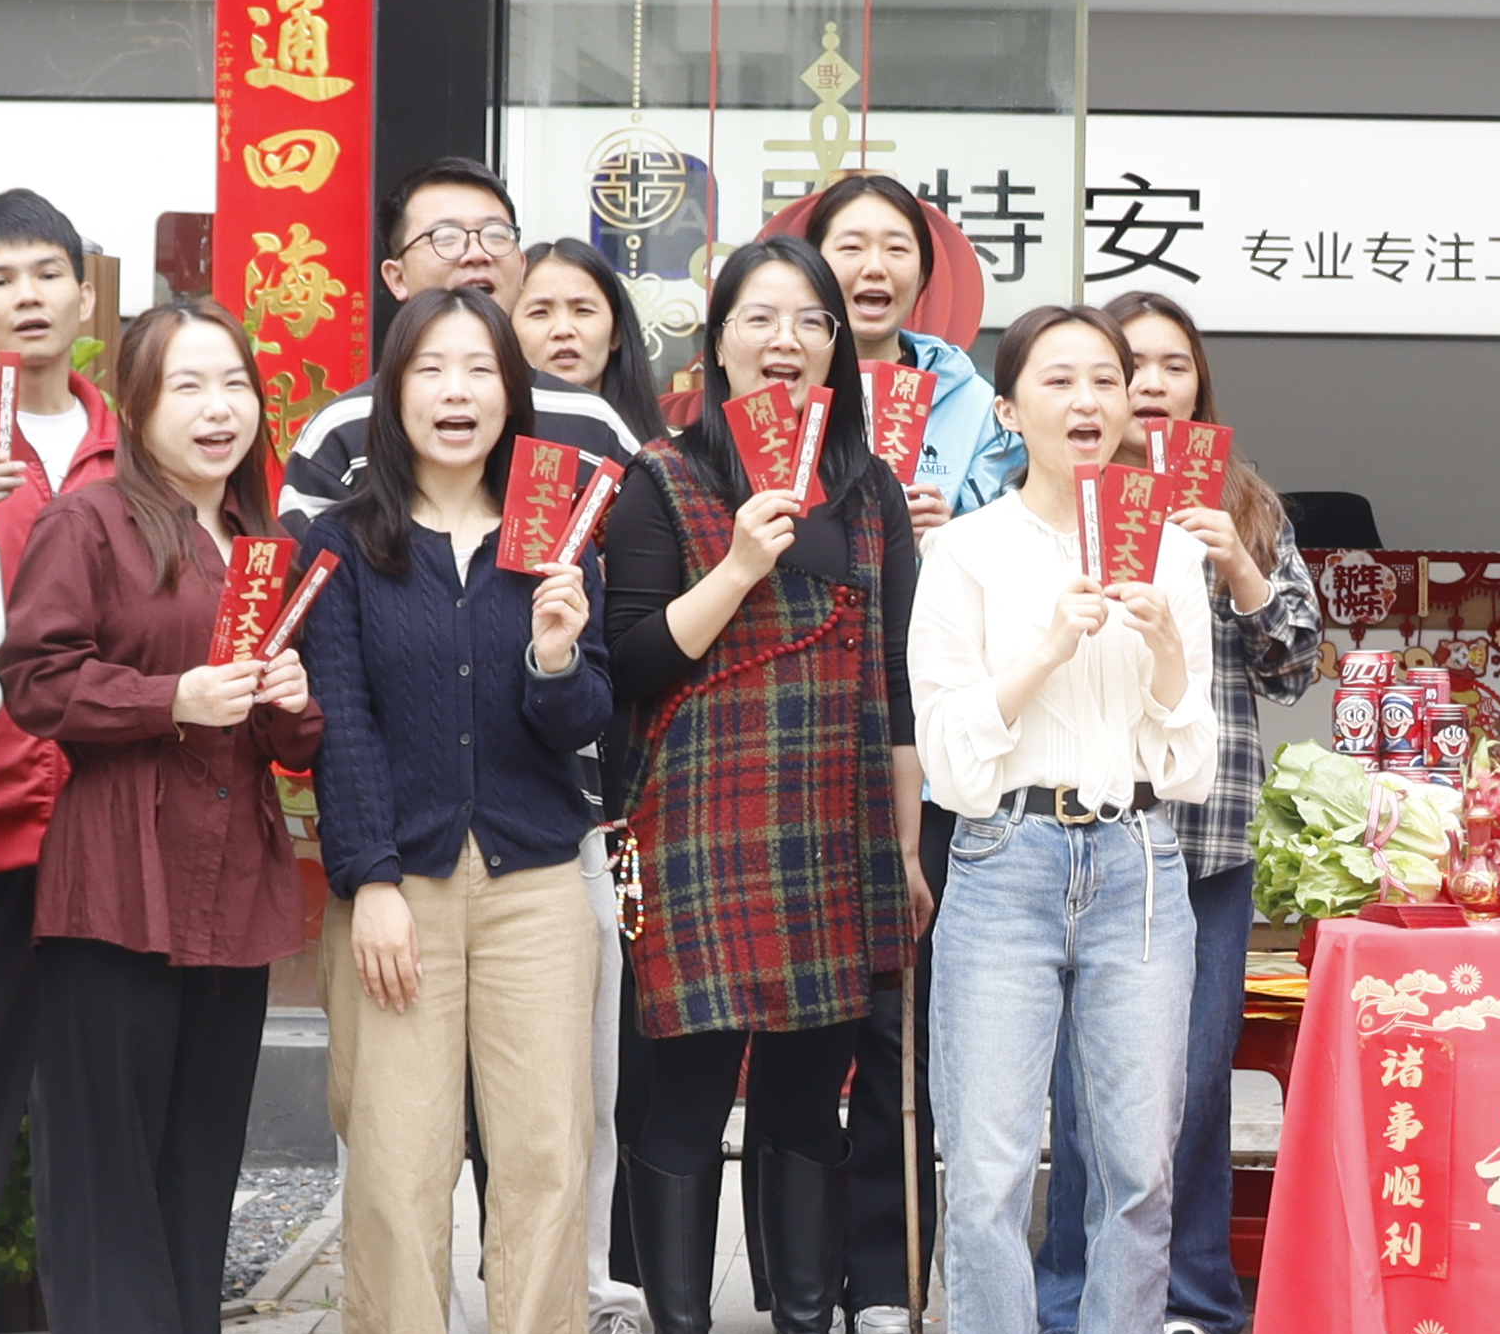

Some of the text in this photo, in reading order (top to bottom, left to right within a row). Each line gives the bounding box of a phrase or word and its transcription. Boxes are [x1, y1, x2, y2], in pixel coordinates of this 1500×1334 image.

[521, 444, 564, 571] 開工大吉
[916, 464, 951, 475] AMEL
[1379, 1043, 1425, 1267] 诸事顺利
